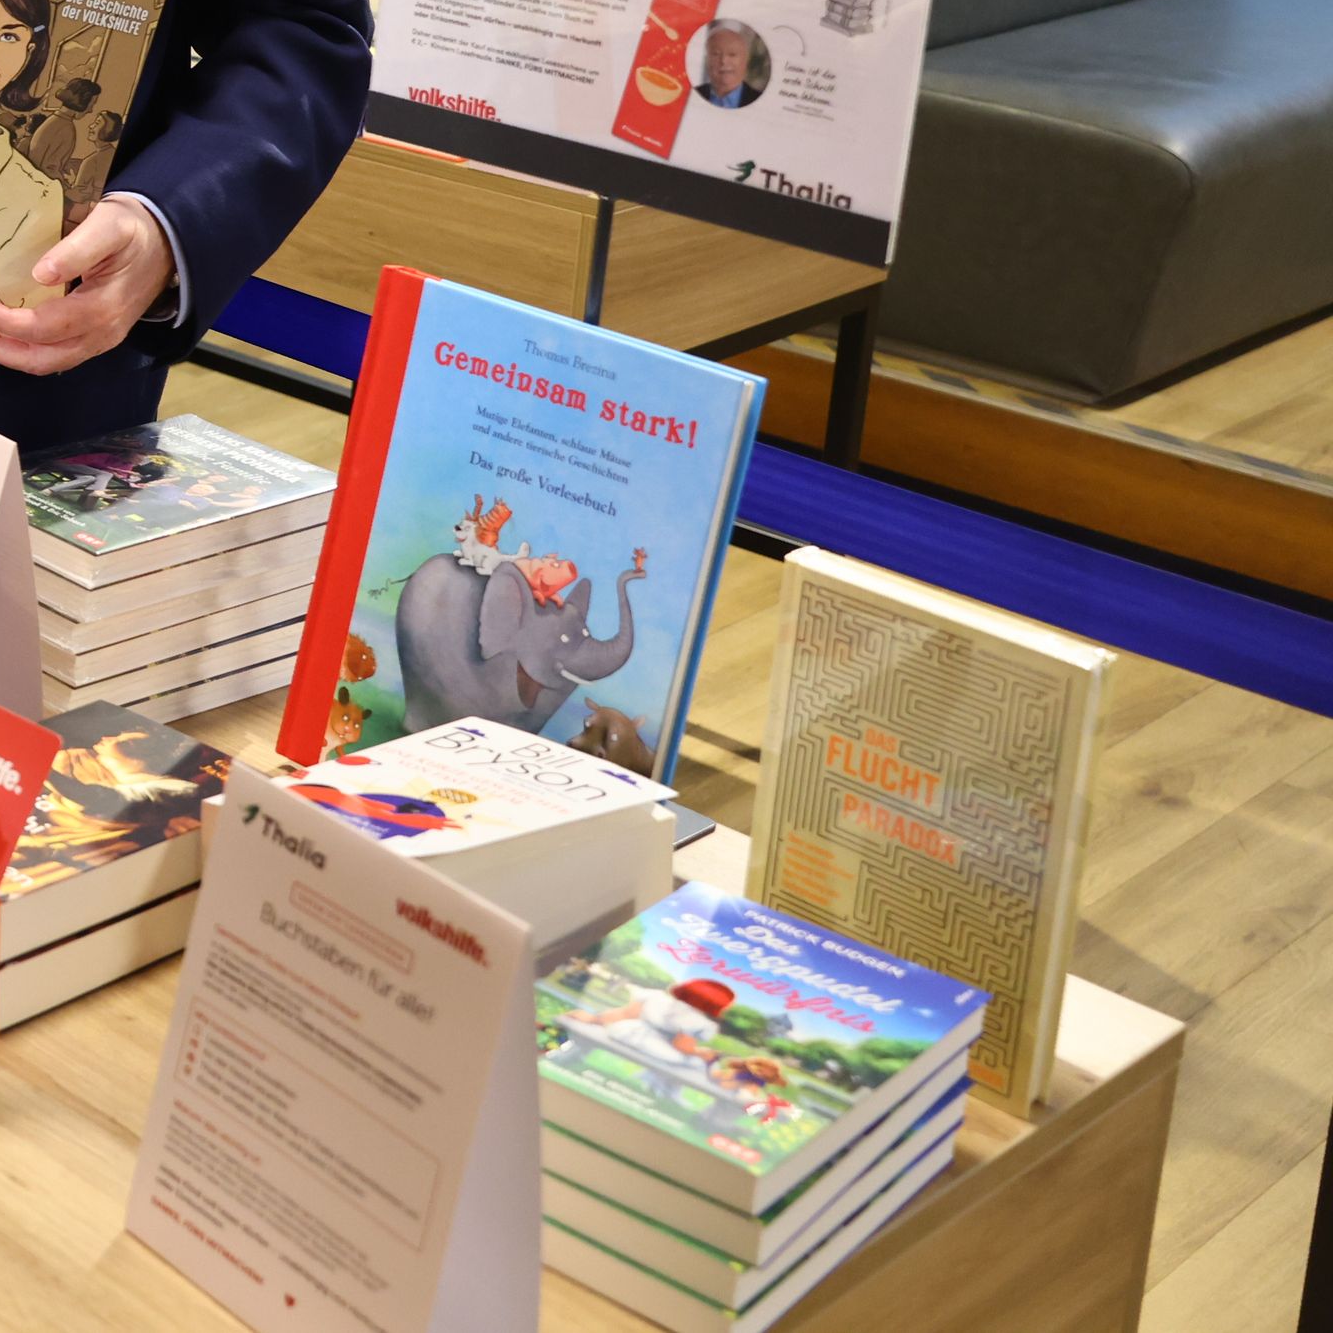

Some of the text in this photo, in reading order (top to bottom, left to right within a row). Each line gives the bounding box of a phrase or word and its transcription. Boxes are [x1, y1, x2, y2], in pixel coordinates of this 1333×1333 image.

[61, 4, 142, 36] der VOLKSHILFE
[760, 168, 852, 210] Thalia
[523, 338, 617, 381] Thomas Brezina
[434, 340, 698, 450] Gemeinsam stark!
[472, 423, 630, 485] und andere tierische Geschichten
[476, 404, 632, 468] Mutige Elefanten, schlaue Mäuse
[469, 451, 618, 518] Das große Vorlesebuch
[425, 730, 607, 802] Bryson
[511, 741, 585, 769] Bill
[825, 733, 941, 808] FLUCHT
[865, 726, 897, 754] DAS
[842, 792, 956, 865] PARADOX
[260, 816, 493, 971] Thalia volkshilfe.
[744, 909, 906, 979] PATRICK BUDGEN
